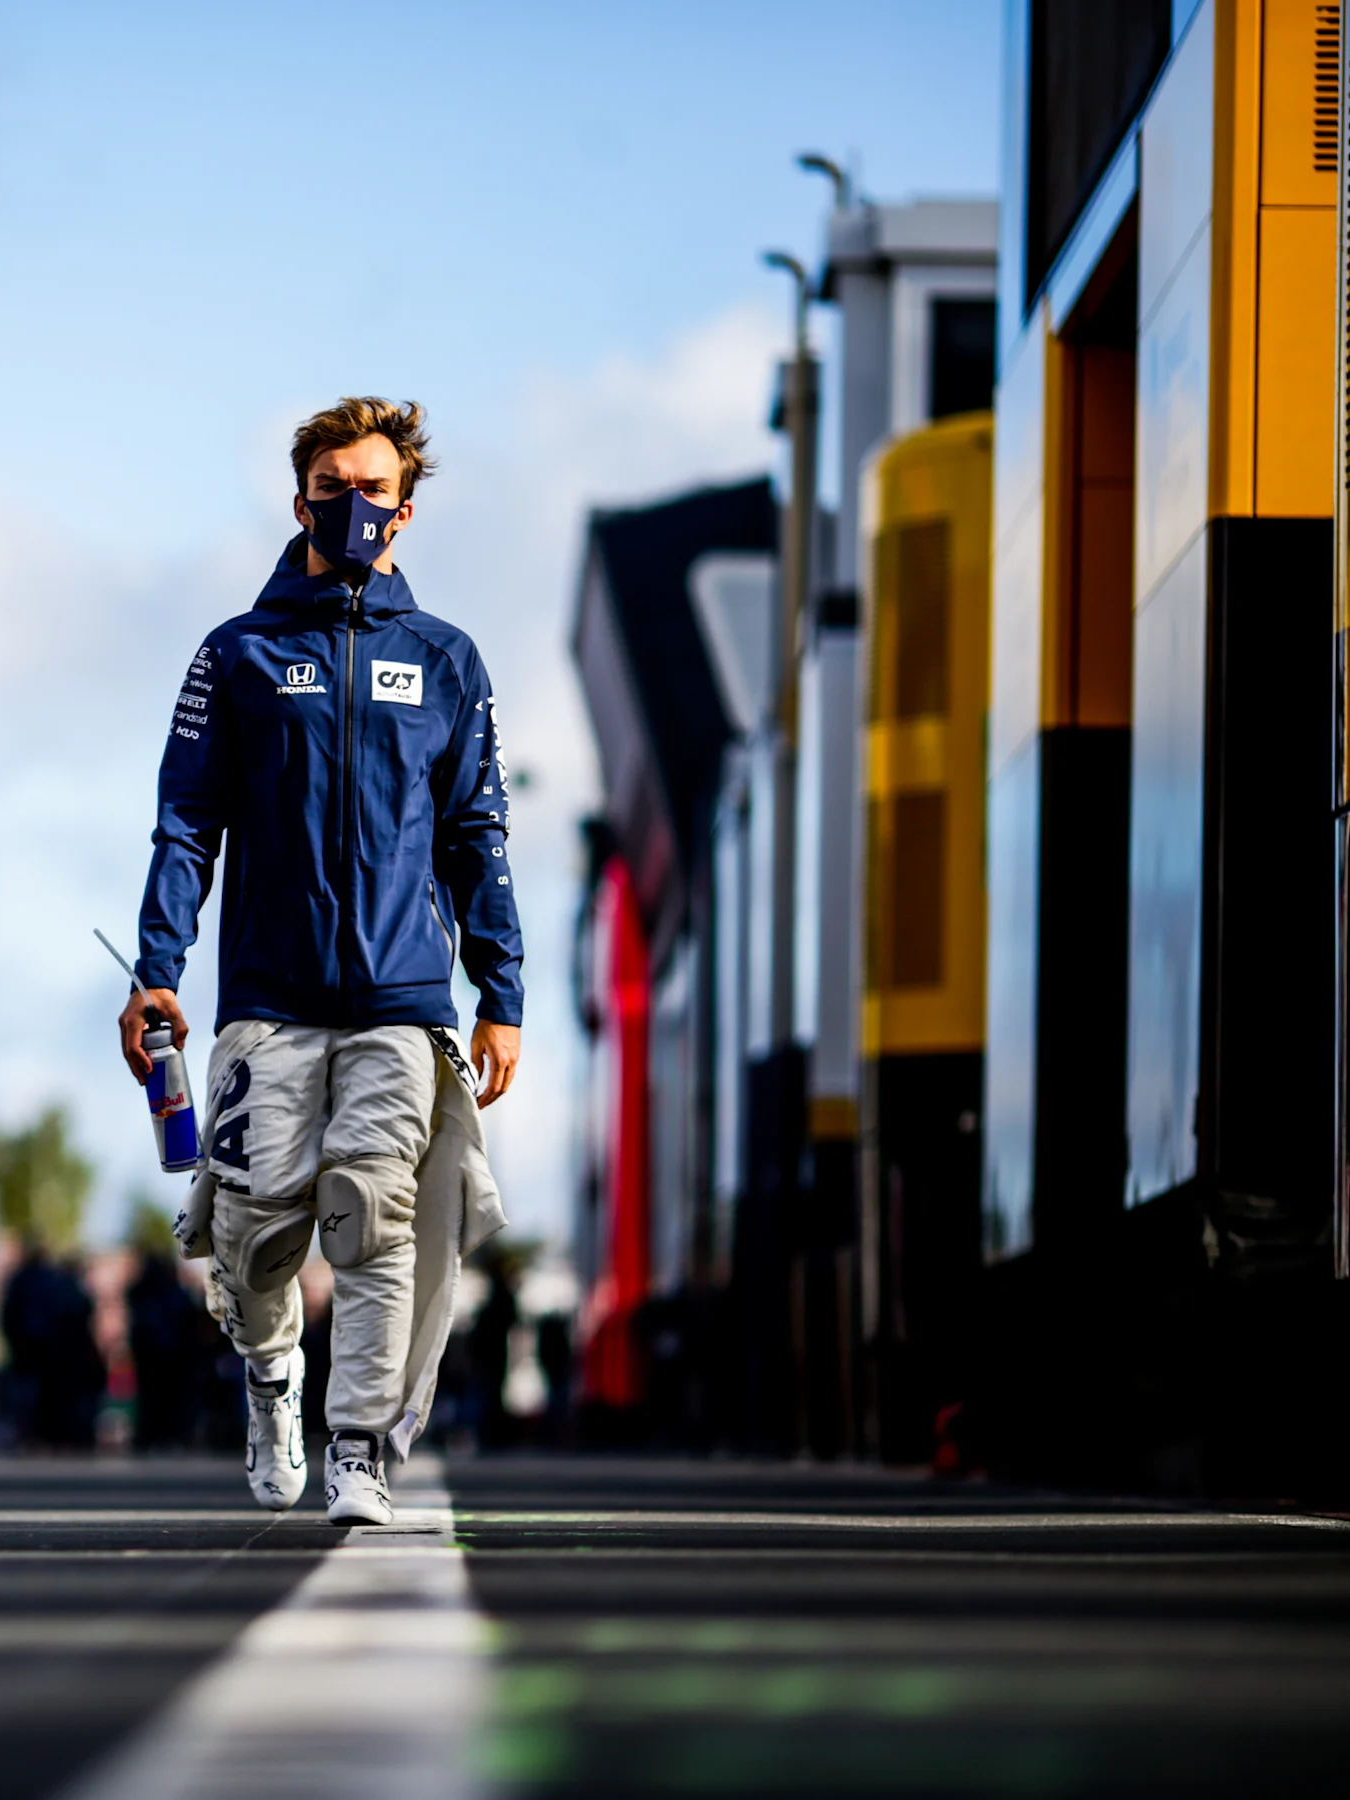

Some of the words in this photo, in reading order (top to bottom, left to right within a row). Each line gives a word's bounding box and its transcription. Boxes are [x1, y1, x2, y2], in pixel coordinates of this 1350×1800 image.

[363, 522, 377, 541] 10
[276, 685, 327, 694] HONDA
[163, 1091, 185, 1107] Bull
